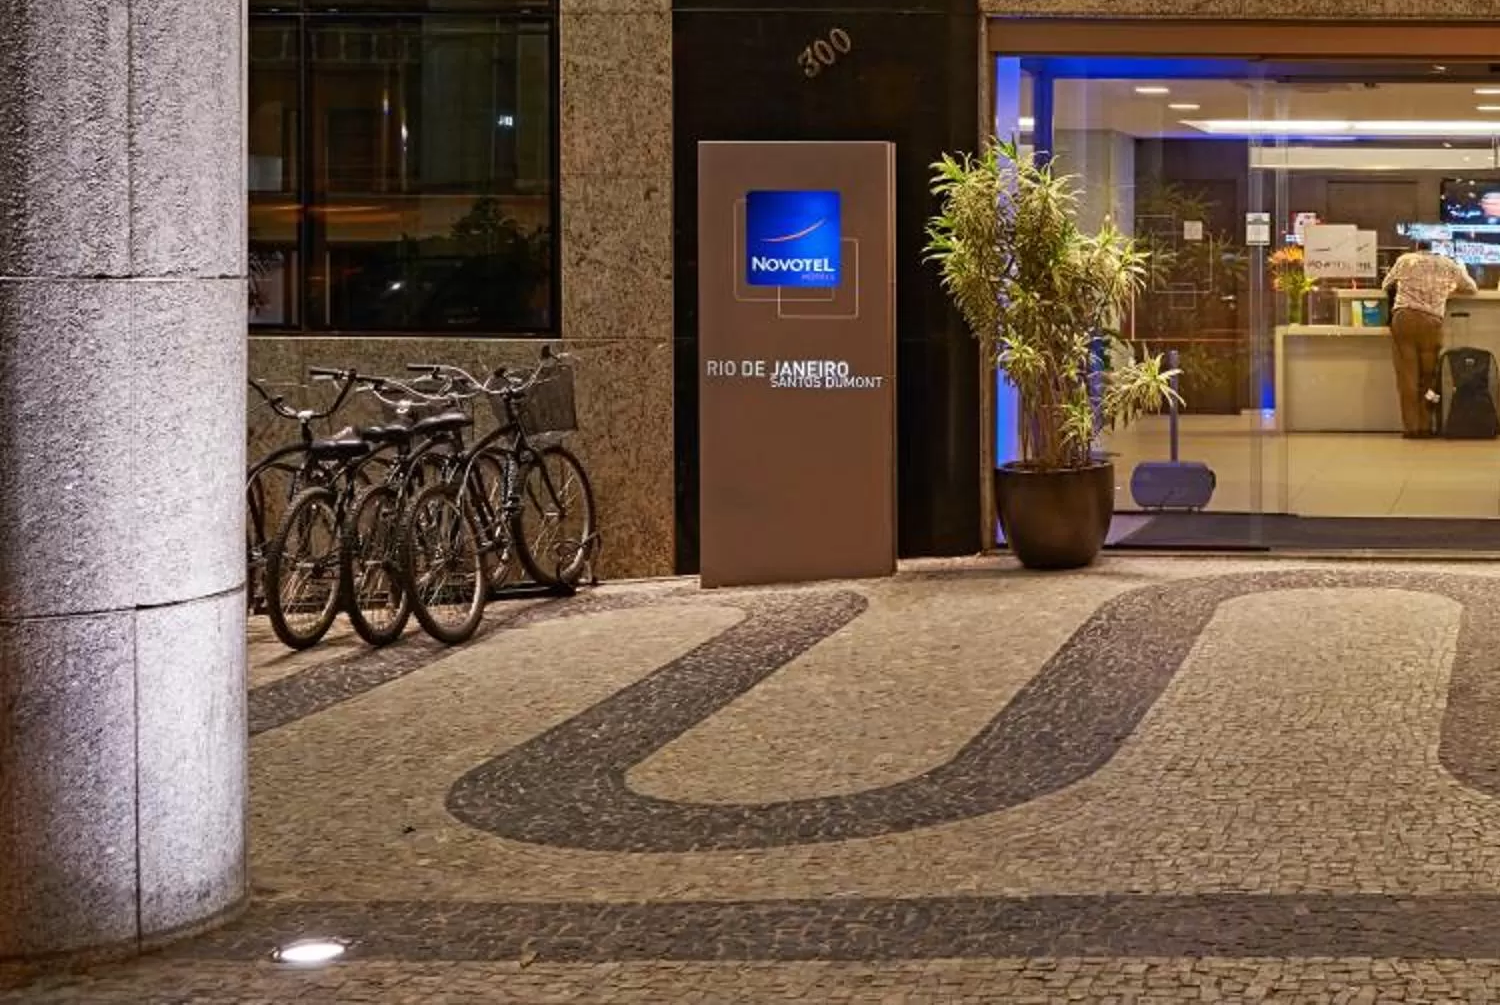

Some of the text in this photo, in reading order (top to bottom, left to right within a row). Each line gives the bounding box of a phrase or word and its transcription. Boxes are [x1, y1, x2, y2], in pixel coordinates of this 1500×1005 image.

[751, 256, 837, 272] NOVOTEL
[706, 359, 849, 377] RIO DE JANEIRO
[770, 375, 883, 388] SANTOS DUMONT
